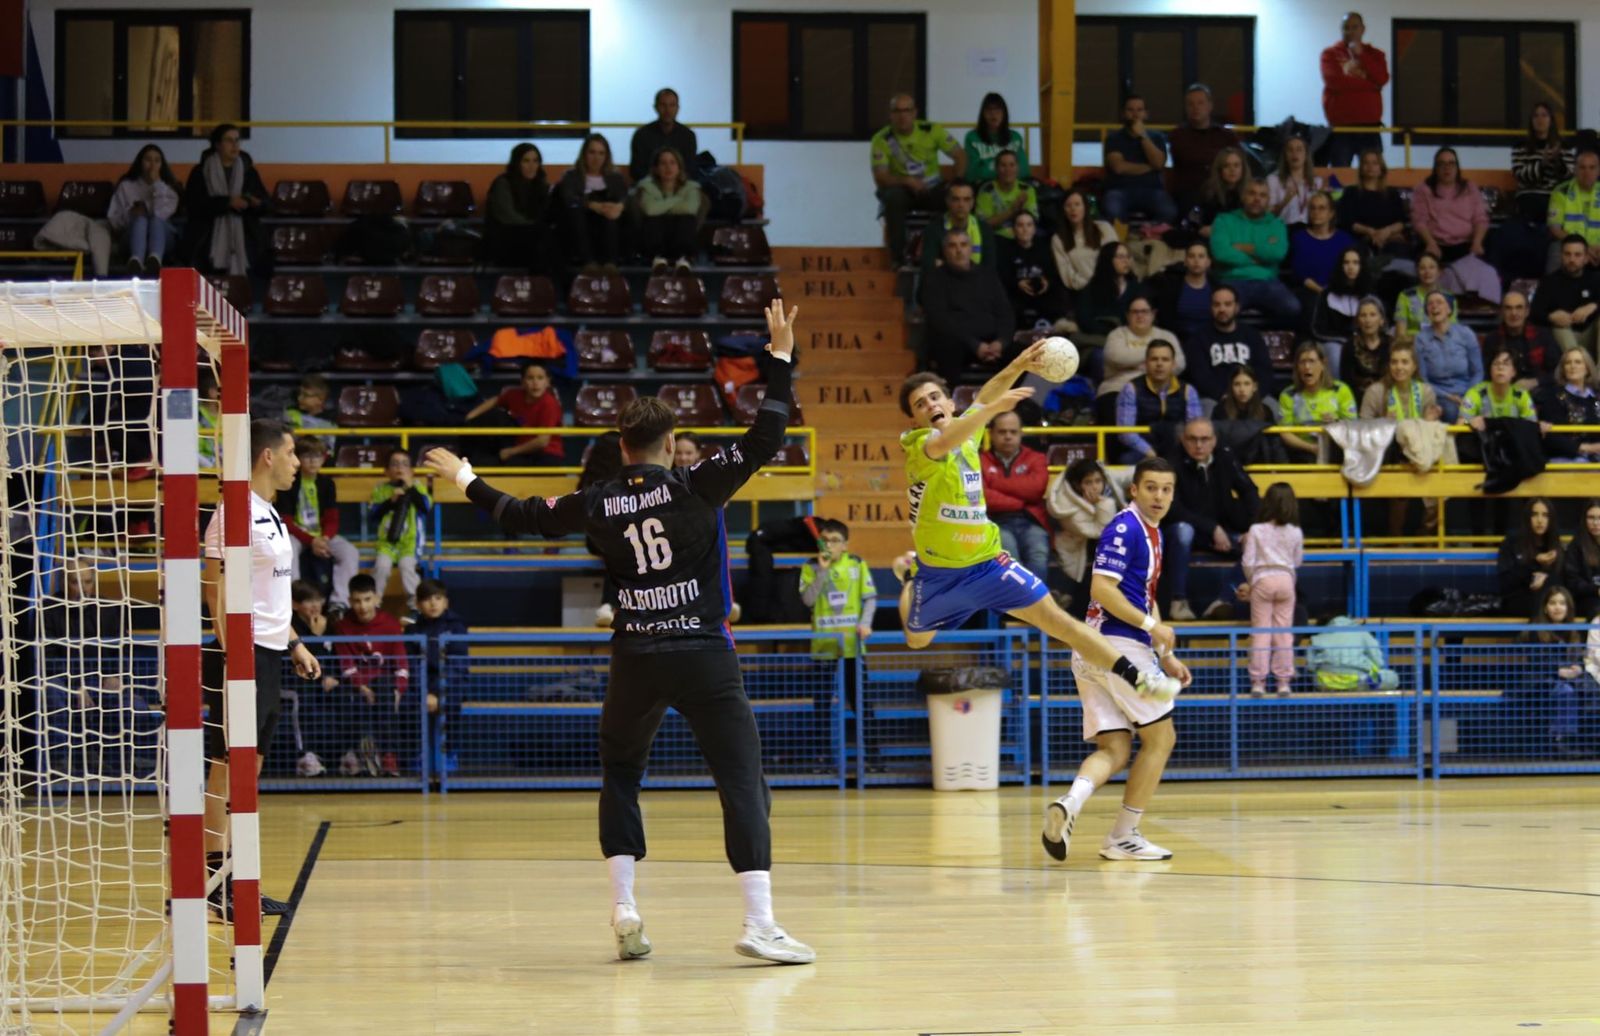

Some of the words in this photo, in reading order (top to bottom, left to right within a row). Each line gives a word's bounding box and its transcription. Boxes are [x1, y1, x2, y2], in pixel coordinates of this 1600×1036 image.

[801, 256, 851, 272] FILA
[805, 281, 855, 296] FILA
[811, 332, 862, 349] FILA
[1210, 342, 1251, 367] GAP
[820, 386, 872, 404] FILA
[834, 443, 889, 460] FILA
[604, 493, 638, 517] HUGO
[848, 504, 903, 520] FILA
[941, 507, 968, 520] CAJA
[623, 517, 673, 575] 16
[618, 578, 700, 611] ALBOROTO
